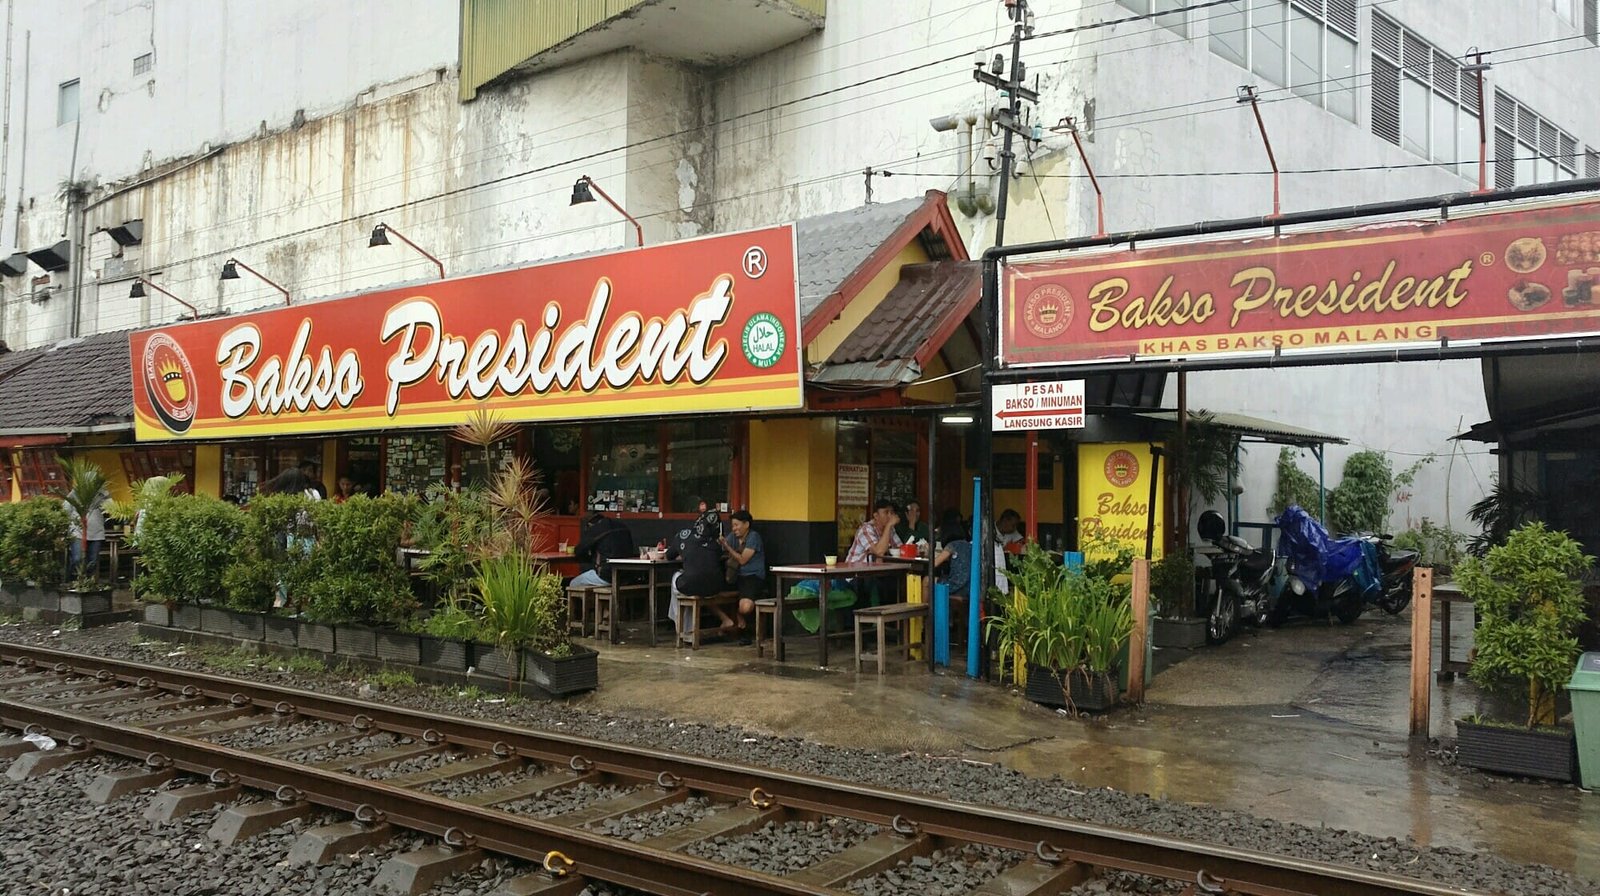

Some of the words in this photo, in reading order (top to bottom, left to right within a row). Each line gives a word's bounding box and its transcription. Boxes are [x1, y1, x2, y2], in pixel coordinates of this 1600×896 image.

[1088, 275, 1216, 332] Bakso
[1230, 259, 1473, 328] President
[216, 317, 364, 420] Bakso
[381, 276, 731, 417] President
[752, 343, 775, 352] HALAL
[1143, 339, 1208, 354] KHAS
[1216, 333, 1304, 350] BAKSO
[1314, 325, 1433, 345] MALANG
[1024, 383, 1063, 395] PESAN
[1006, 398, 1035, 410] BAKSO
[1041, 395, 1083, 408] MINUMAN
[1004, 417, 1053, 429] LANGSUNG
[1054, 415, 1083, 427] KASIR
[1097, 492, 1149, 516] Bakso
